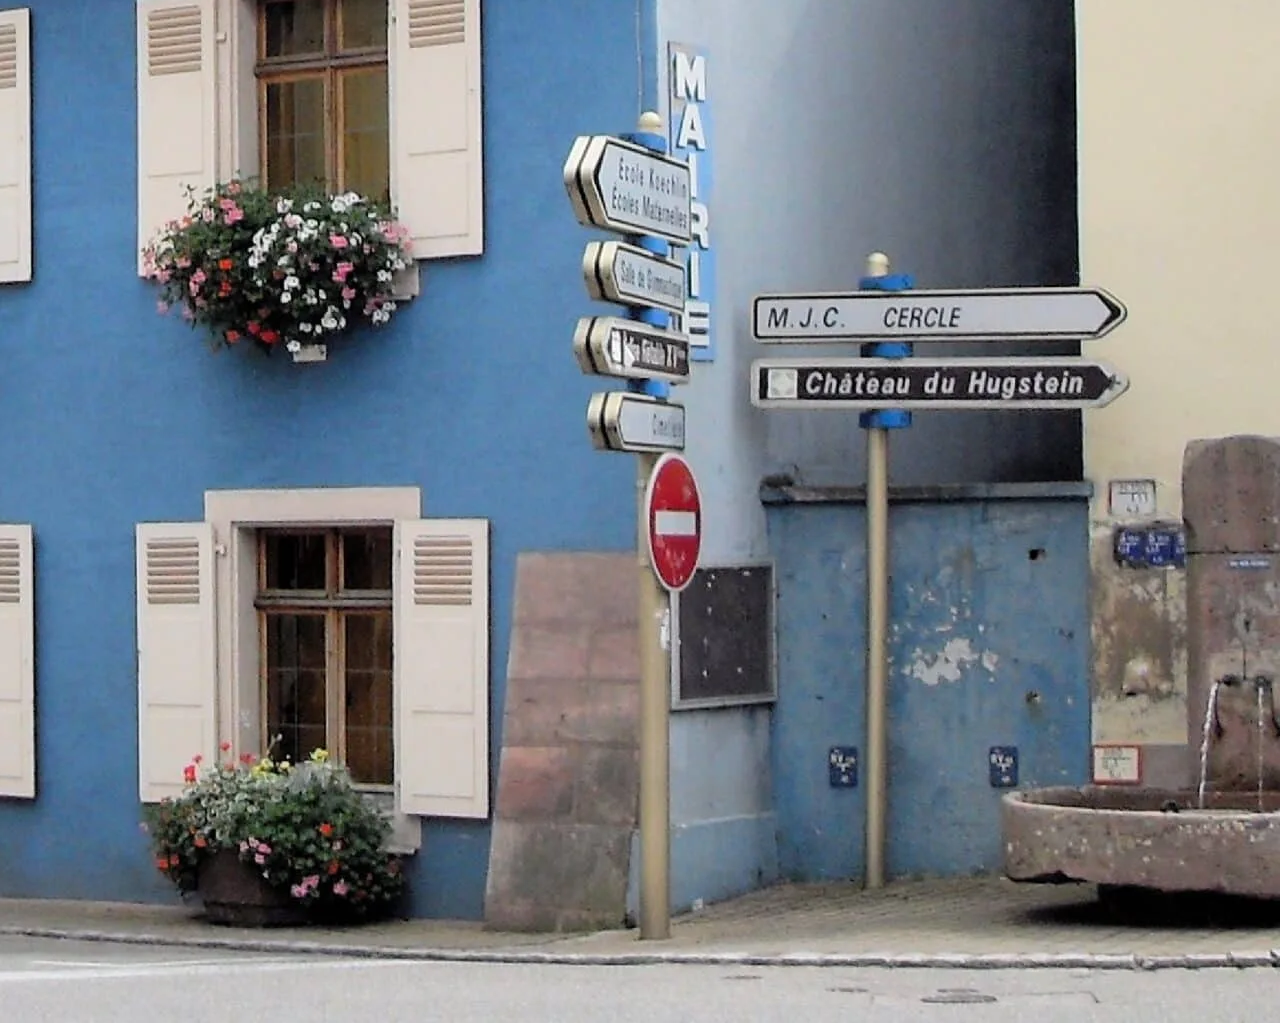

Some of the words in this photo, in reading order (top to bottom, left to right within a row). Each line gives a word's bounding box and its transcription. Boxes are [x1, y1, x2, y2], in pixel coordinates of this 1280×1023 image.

[642, 194, 687, 230] Maternelles
[674, 50, 710, 347] MAIRIE
[883, 306, 962, 328] CERCLE
[805, 371, 911, 395] Château
[923, 371, 957, 395] du
[968, 370, 1085, 399] Hugstein
